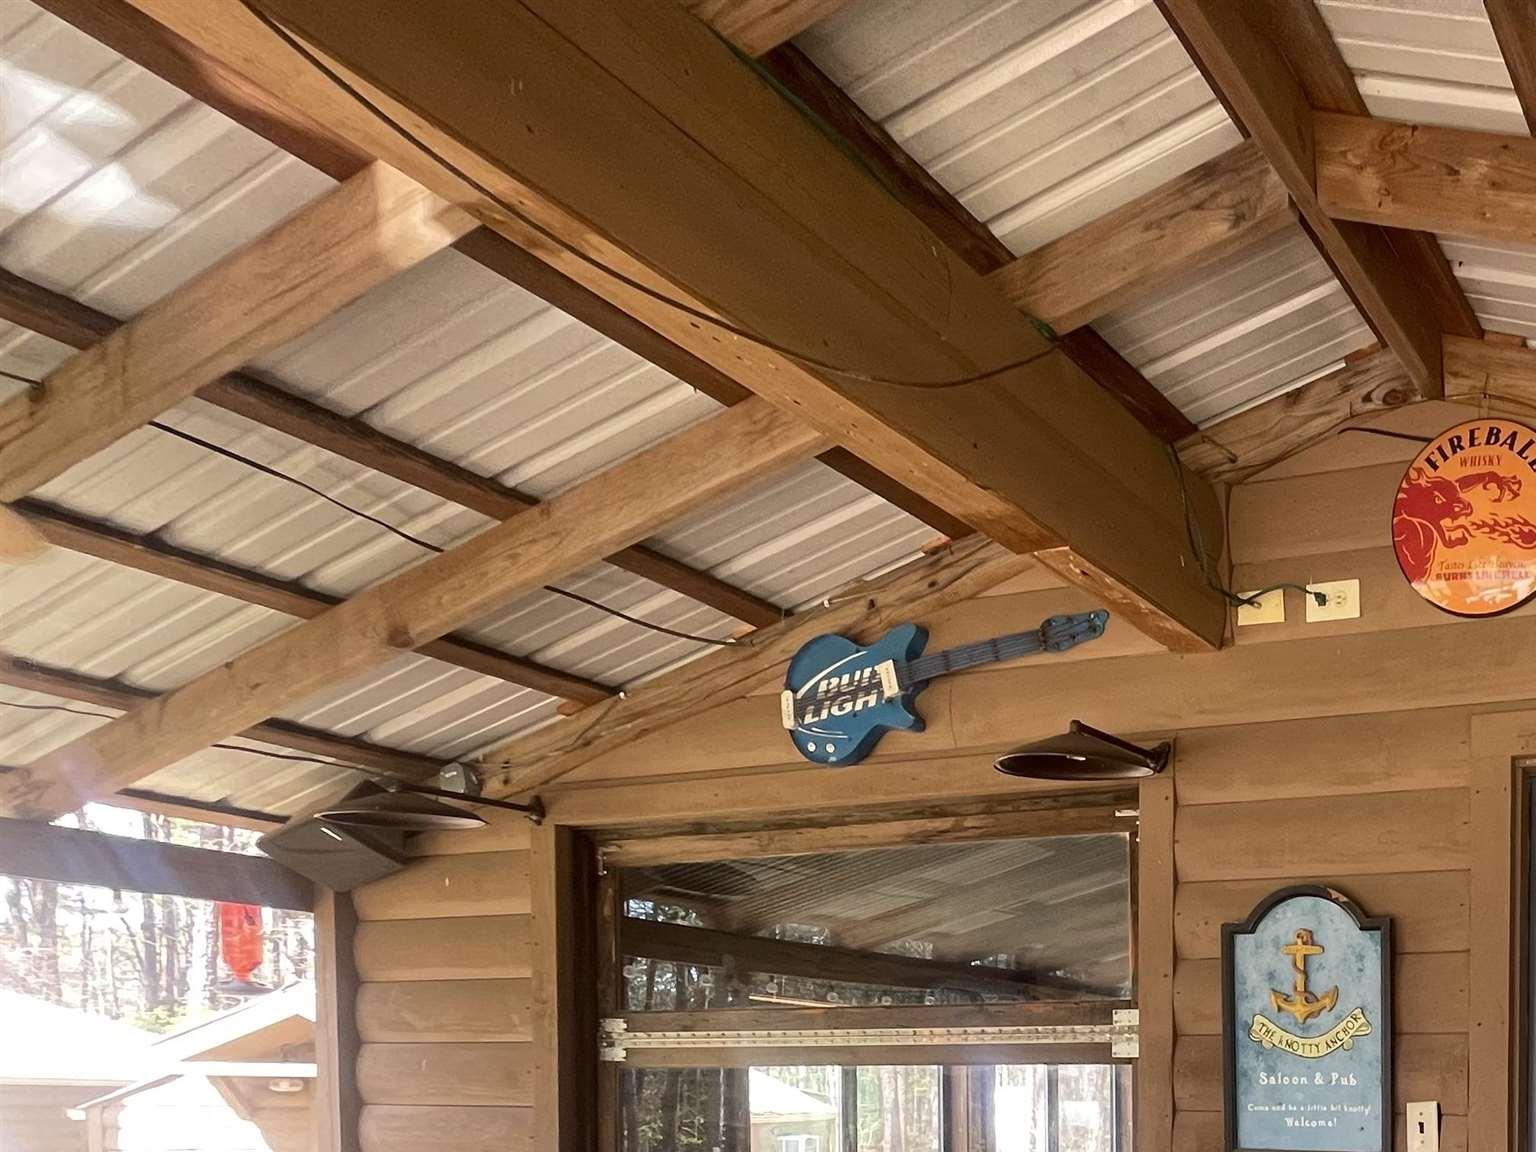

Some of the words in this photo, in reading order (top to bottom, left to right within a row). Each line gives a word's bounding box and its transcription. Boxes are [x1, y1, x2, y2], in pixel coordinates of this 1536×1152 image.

[1459, 455, 1503, 468] WHISKY
[803, 689, 886, 725] LIGH
[1259, 1022, 1277, 1041] THE
[1325, 1013, 1362, 1051] ANCHOR
[1259, 1071, 1308, 1085] Saloon
[1314, 1072, 1325, 1085] &
[1331, 1072, 1359, 1086] Pub
[1285, 1116, 1337, 1127] Welcome!
